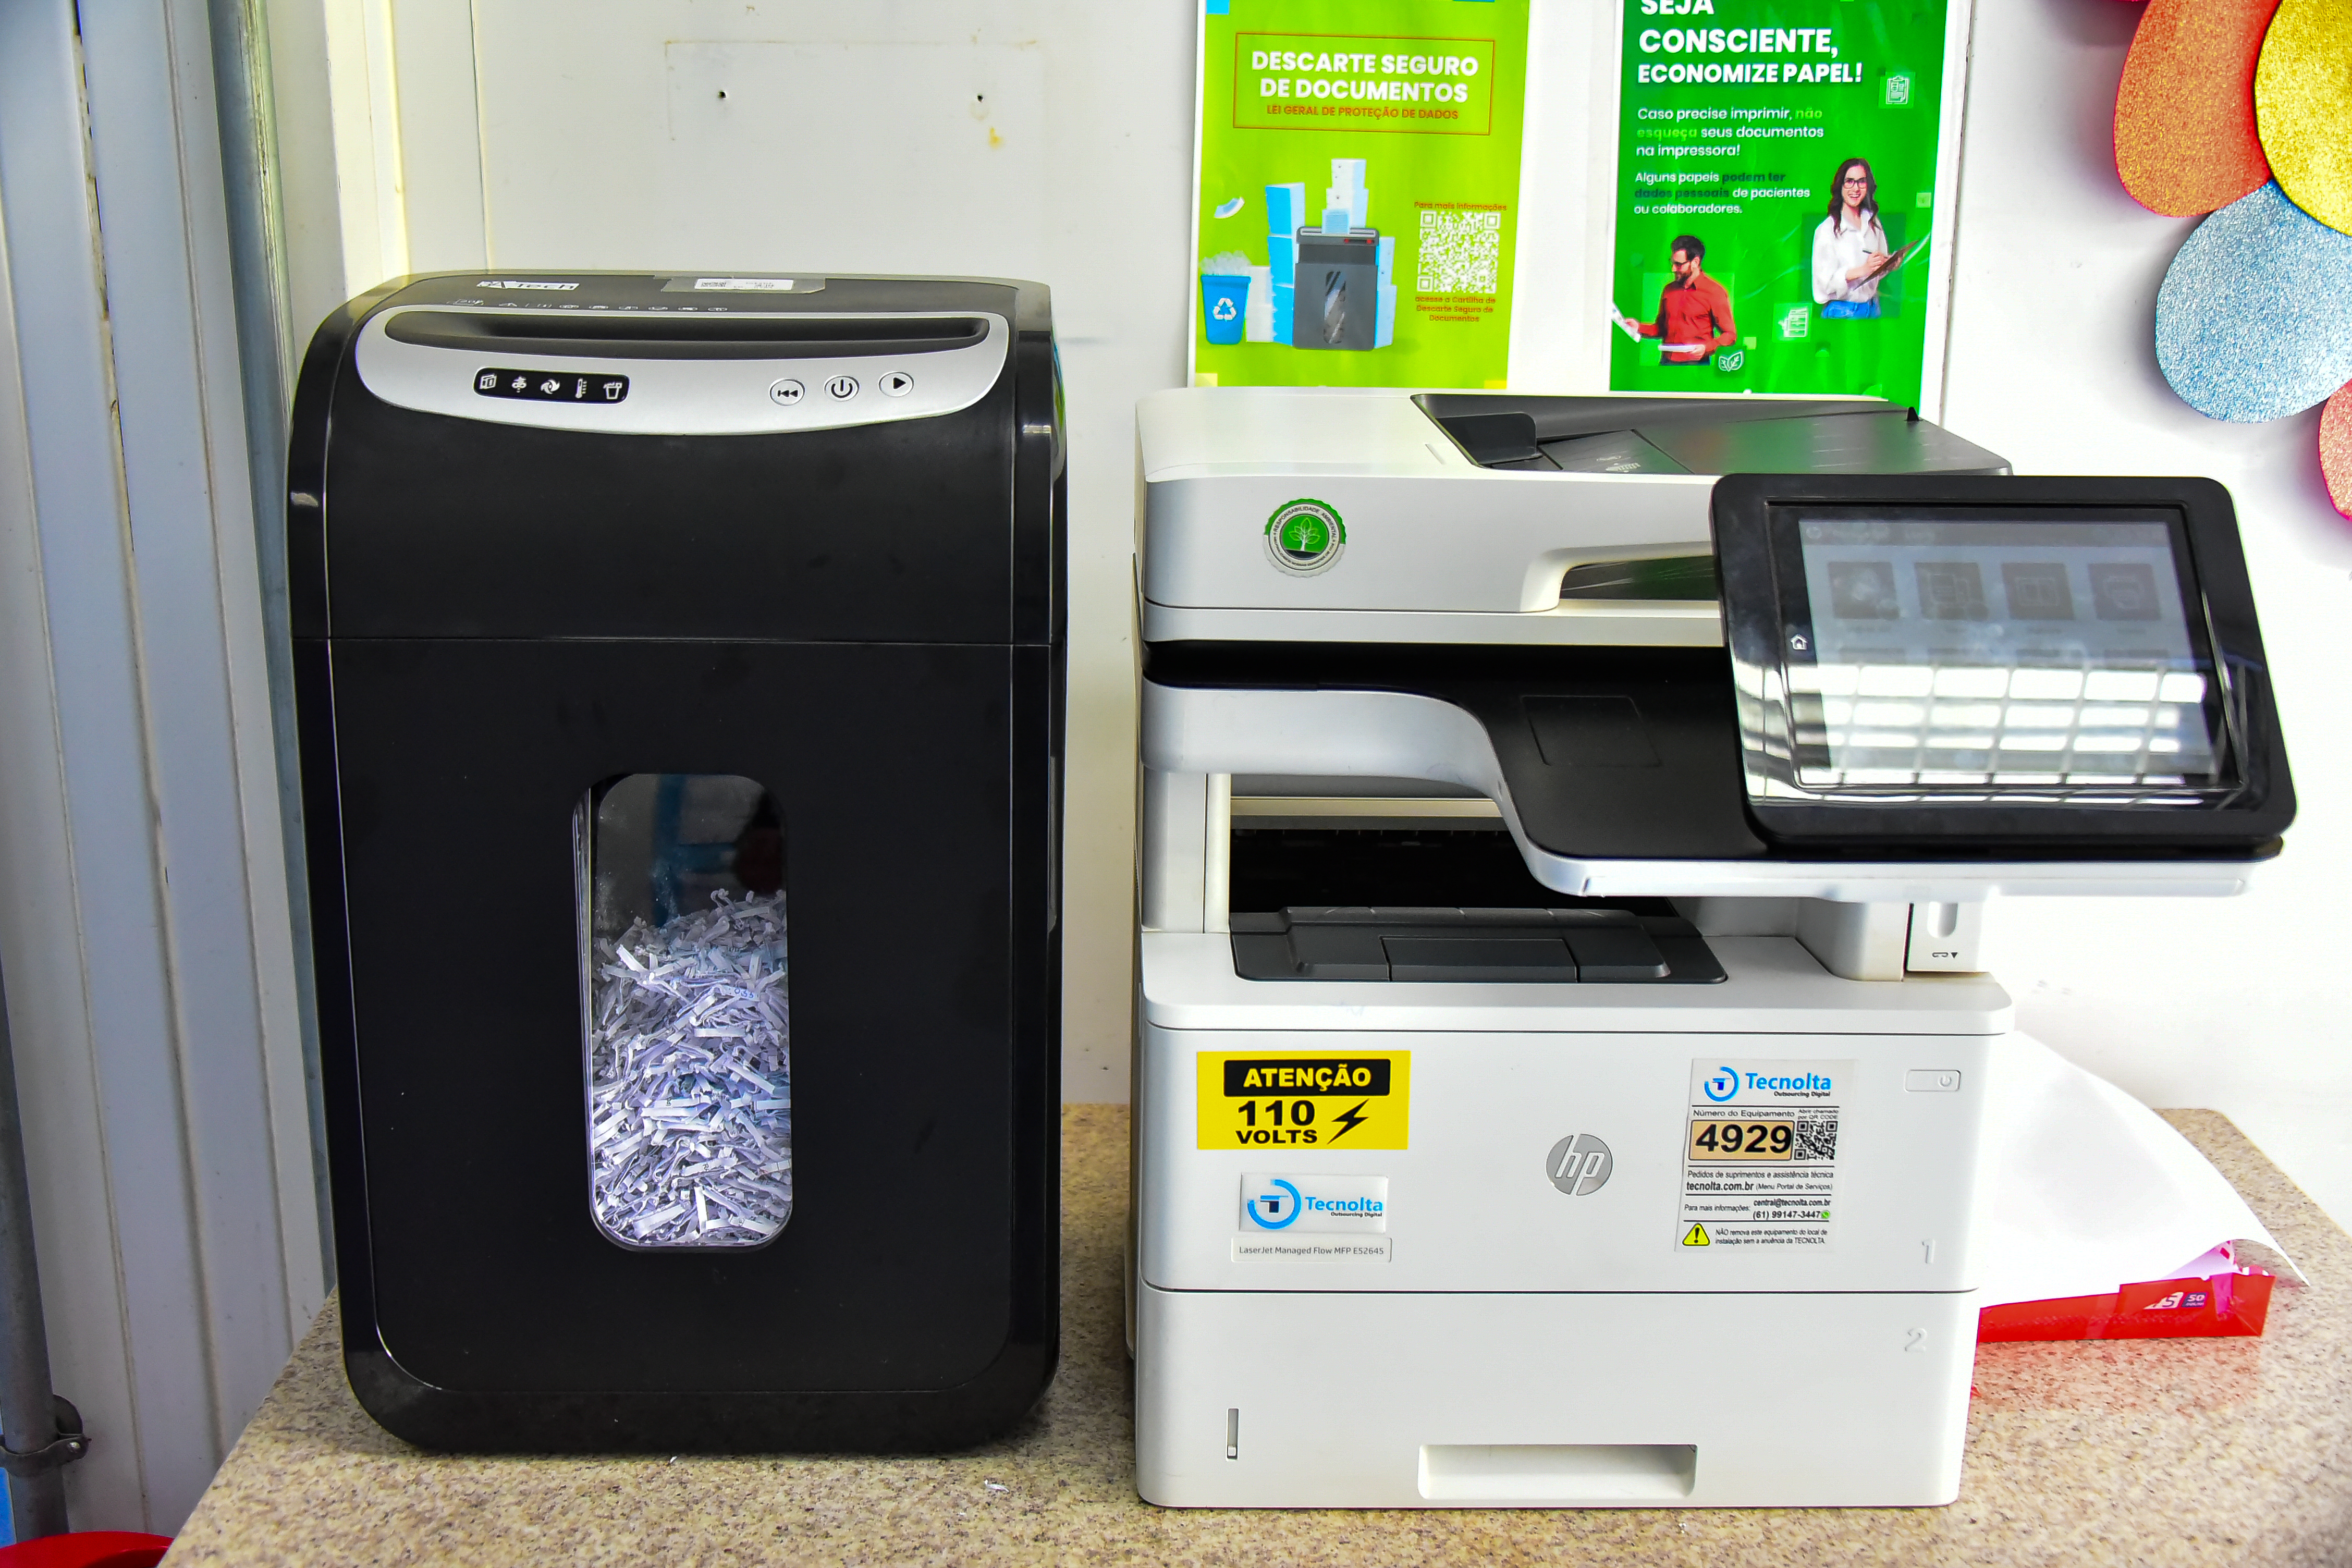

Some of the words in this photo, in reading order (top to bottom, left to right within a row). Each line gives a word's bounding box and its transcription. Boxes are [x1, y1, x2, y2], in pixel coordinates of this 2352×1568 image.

[1640, 0, 1714, 15] SEJA
[1638, 28, 1838, 59] CONSCIENTE,
[1252, 51, 1376, 74] DESCARTE
[1380, 54, 1479, 77] SEGURO
[1637, 63, 1778, 83] ECONOMIZE
[1783, 62, 1863, 83] PAPEL!
[1259, 78, 1290, 98] DE
[1295, 79, 1468, 103] DOCUMENTOS
[1267, 105, 1281, 114] LEI
[1284, 105, 1318, 116] GERAL
[1322, 106, 1336, 116] DE
[1338, 105, 1399, 119] PROTEÇÃO
[1403, 108, 1416, 118] DE
[1418, 109, 1459, 120] DADOS
[1637, 108, 1673, 120] Caso
[1676, 107, 1728, 123] precise
[1730, 108, 1792, 123] imprimir,
[1795, 109, 1823, 120] não
[1636, 128, 1698, 142] esqueça
[1700, 127, 1733, 139] seus
[1735, 126, 1824, 139] documentos
[1636, 145, 1655, 156] na
[1658, 144, 1740, 159] impressora!
[1635, 172, 1676, 186] Alguns
[1679, 172, 1719, 185] papeis
[1722, 173, 1766, 185] podem
[1768, 173, 1786, 182] ter
[1634, 189, 1673, 199] dados
[1675, 188, 1730, 201] pessoais
[1732, 187, 1748, 198] de
[1750, 187, 1811, 201] pacientes
[1456, 203, 1507, 212] informações
[1634, 205, 1649, 214] ou
[1651, 203, 1743, 214] colaboradores.
[1453, 306, 1481, 315] Seguro
[1243, 1063, 1371, 1091] ATENÇÃO
[1746, 1073, 1831, 1090] Tecnolta
[1238, 1100, 1315, 1126] 110
[1235, 1130, 1317, 1144] VOLTS
[1696, 1124, 1793, 1153] 4929
[1555, 1134, 1605, 1196] hp
[1725, 1171, 1765, 1179] suprimentos
[1686, 1181, 1754, 1191] tecnolta.com.br
[1305, 1197, 1383, 1211] Tecnolta
[1753, 1198, 1831, 1208] central@tecnolta.com.br
[1753, 1210, 1769, 1220] (61)
[1275, 1247, 1312, 1256] Managed
